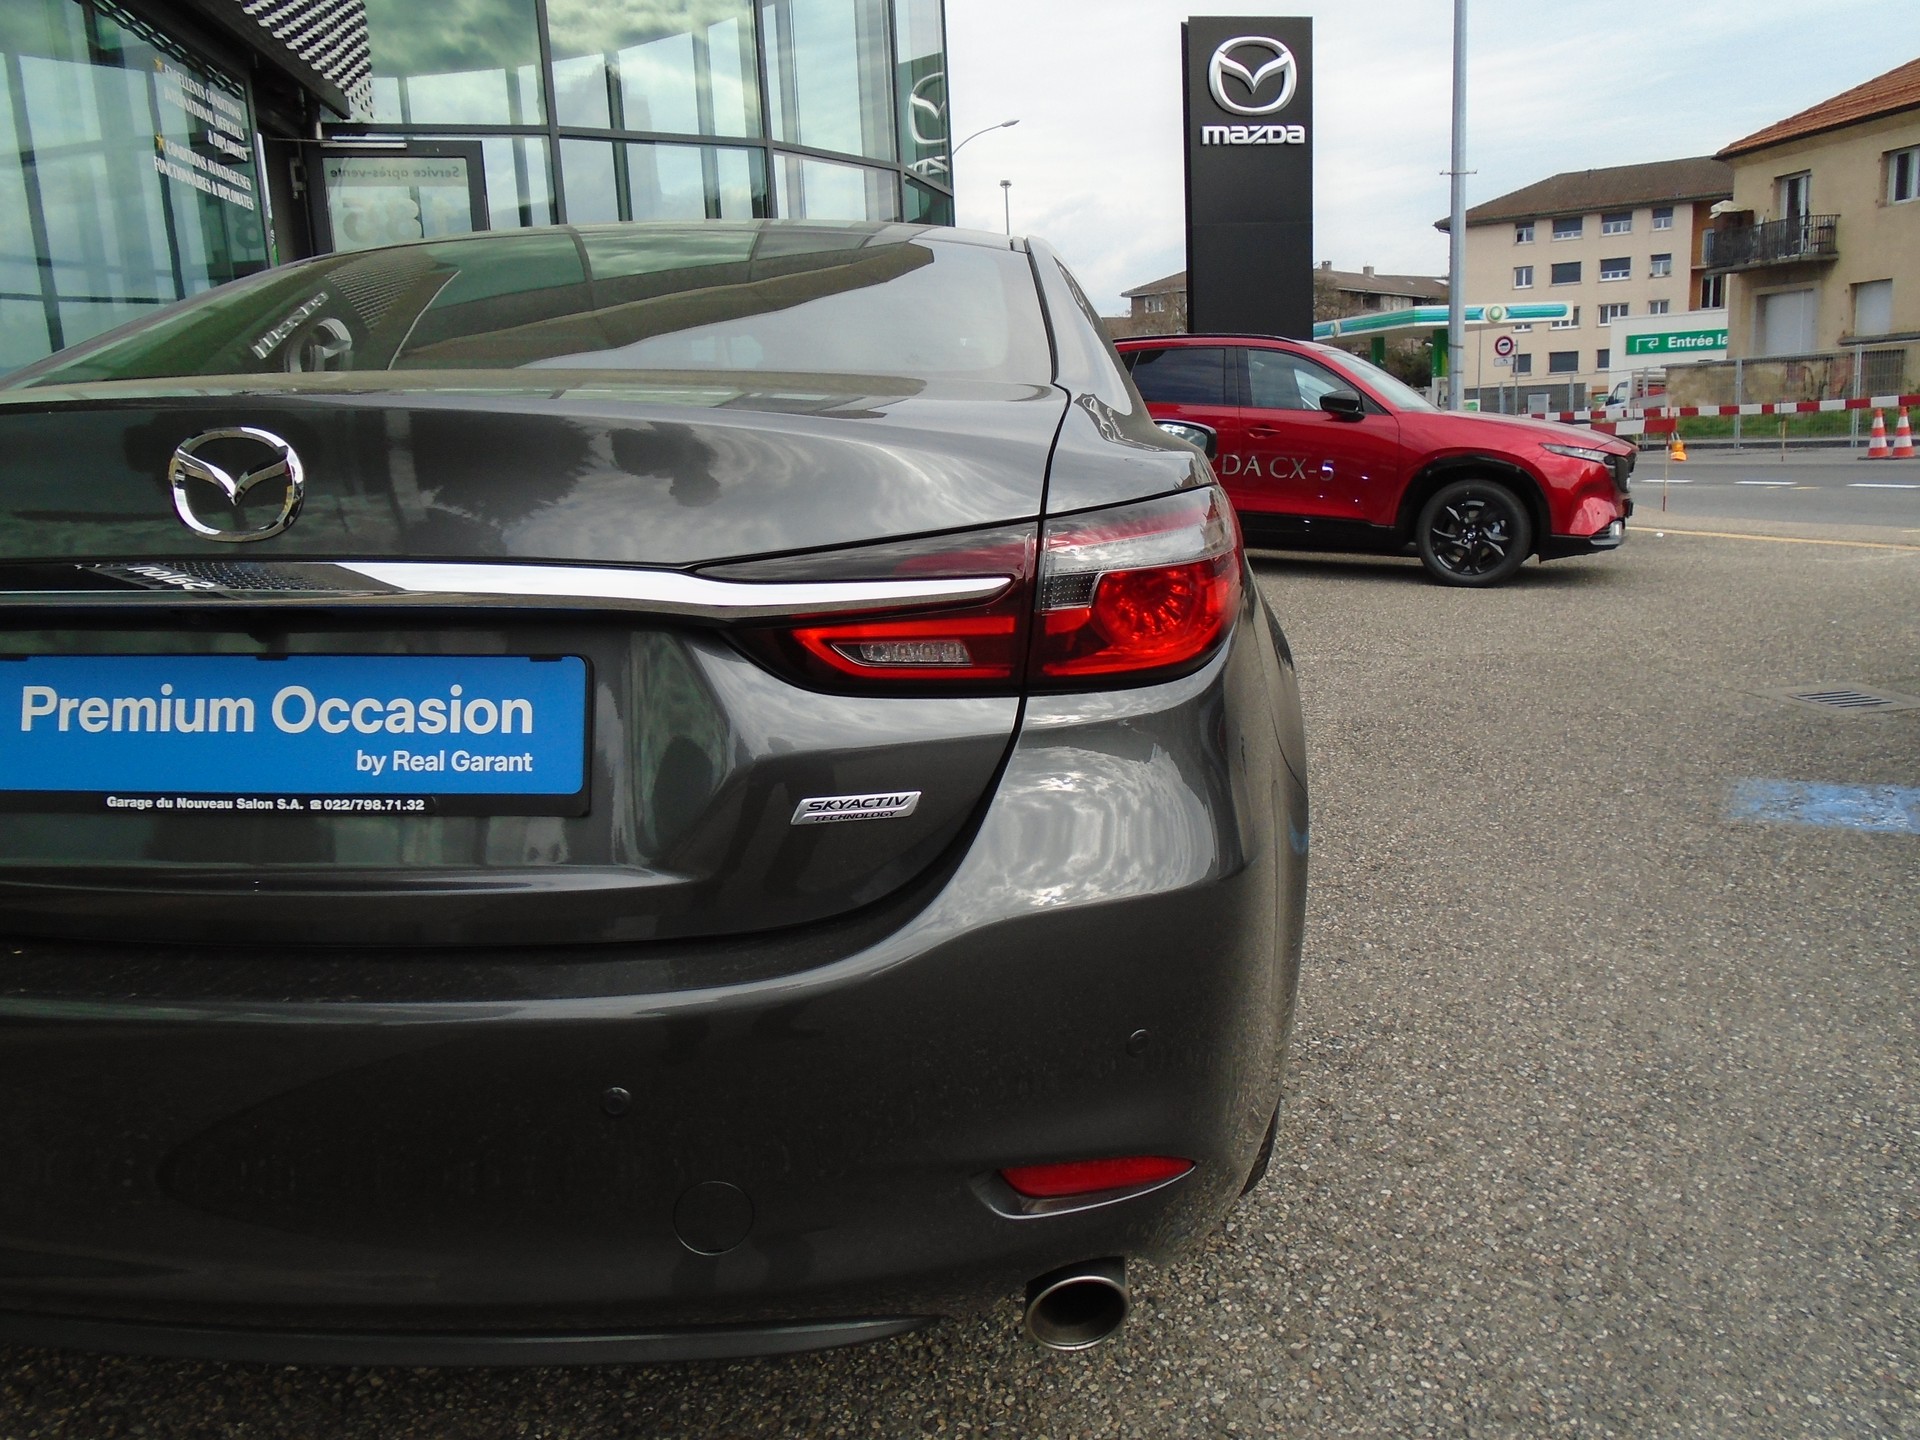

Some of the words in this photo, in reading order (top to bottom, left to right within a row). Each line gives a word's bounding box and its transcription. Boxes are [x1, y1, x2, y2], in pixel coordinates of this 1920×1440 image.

[164, 64, 206, 100] EELLENTS
[1667, 334, 1713, 348] Entrée
[1269, 457, 1335, 481] CX-5
[20, 683, 255, 733] Premium
[271, 684, 533, 735] Occasion
[356, 750, 387, 776] by
[392, 750, 445, 772] Real
[451, 750, 533, 772] Garant
[106, 796, 153, 810] Garage
[156, 797, 173, 809] du
[176, 797, 233, 809] Nouveau
[236, 798, 274, 809] Salon
[276, 798, 304, 810] S.A.
[323, 799, 425, 811] 022/798.71.32
[806, 795, 910, 812] SKYACTIV
[814, 810, 897, 822] TECHNOLOGY
